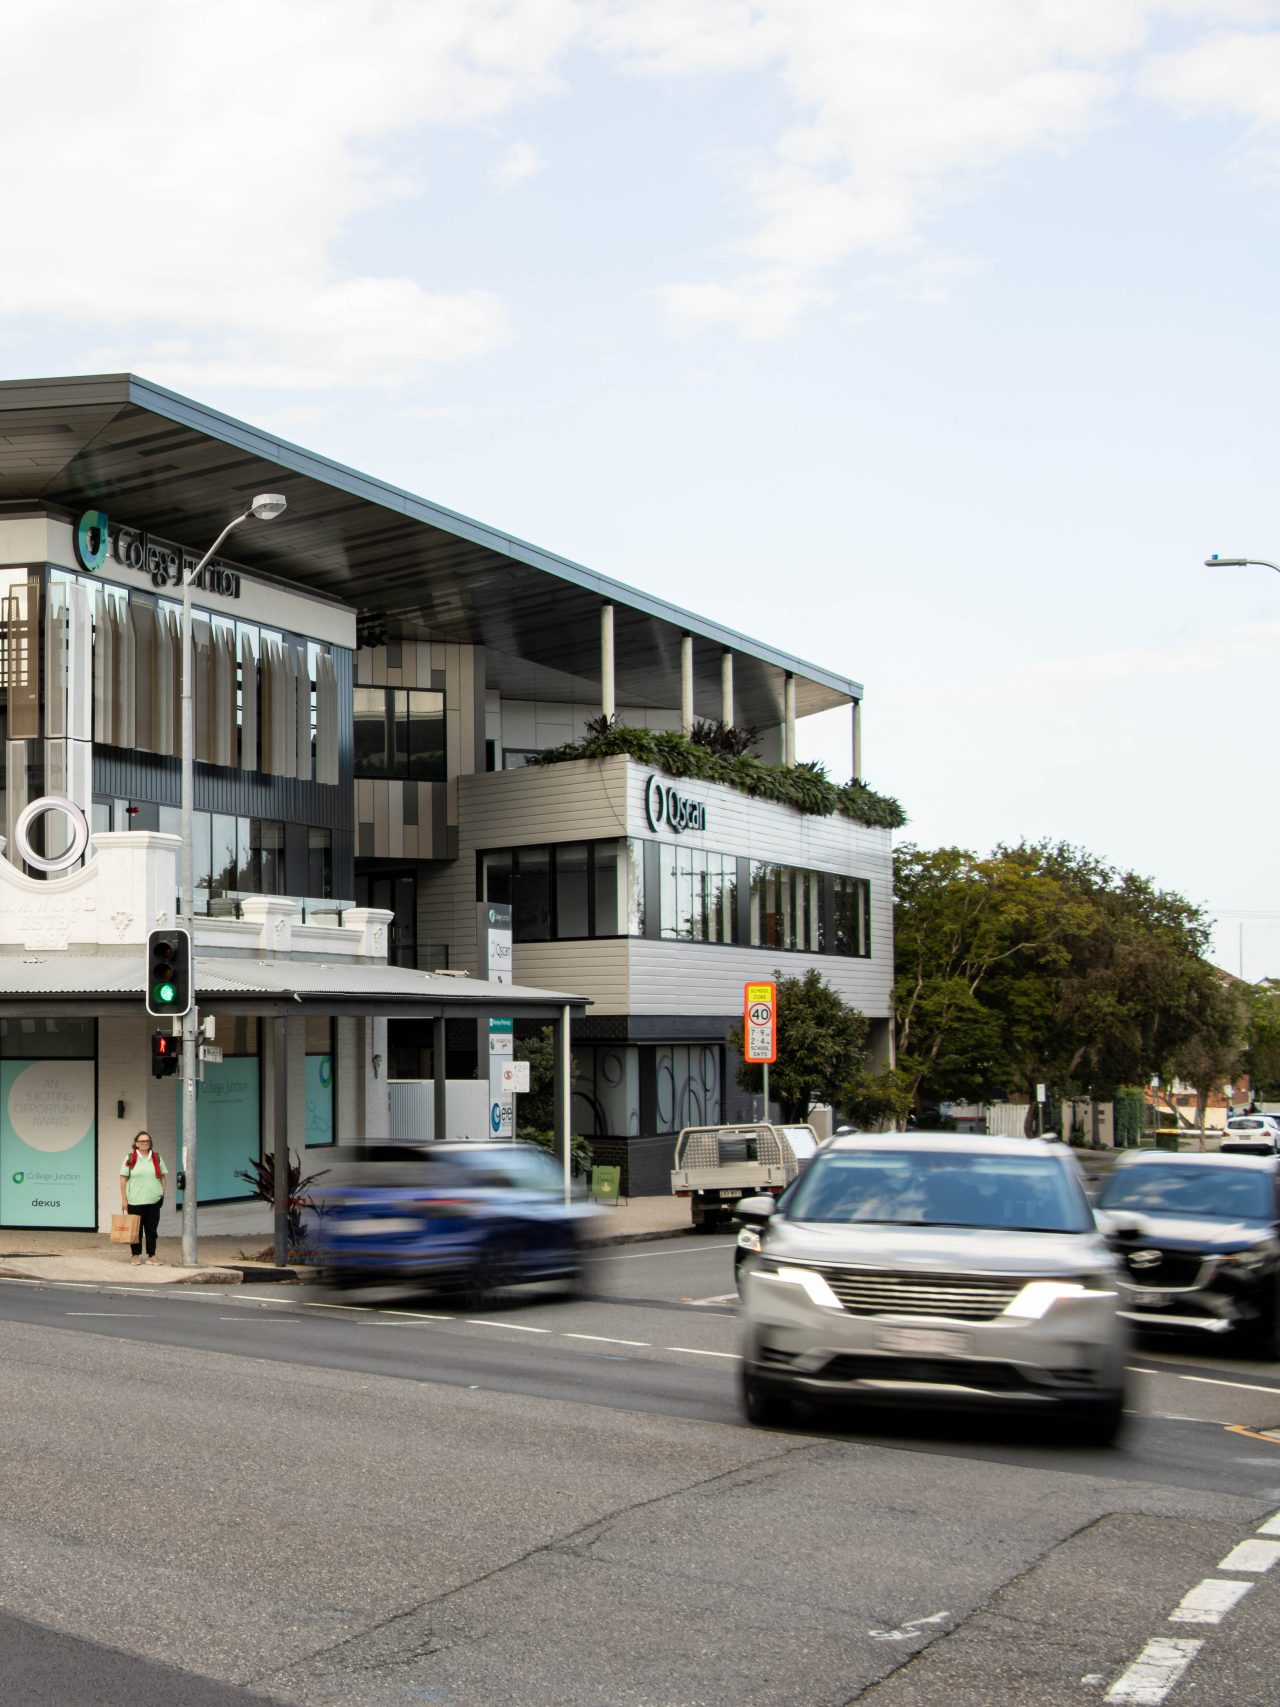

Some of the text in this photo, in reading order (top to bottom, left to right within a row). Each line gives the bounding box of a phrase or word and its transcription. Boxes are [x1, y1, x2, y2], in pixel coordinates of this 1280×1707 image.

[112, 529, 177, 588] College
[666, 787, 706, 834] Qscan
[752, 1008, 769, 1020] 40
[43, 1079, 59, 1089] AN
[26, 1091, 76, 1102] EXCITING
[15, 1103, 89, 1114] OPPORTUNITY
[32, 1116, 71, 1127] AWAITS
[26, 1171, 81, 1181] College Junction
[31, 1198, 61, 1207] dexus
[114, 1224, 130, 1232] coles
